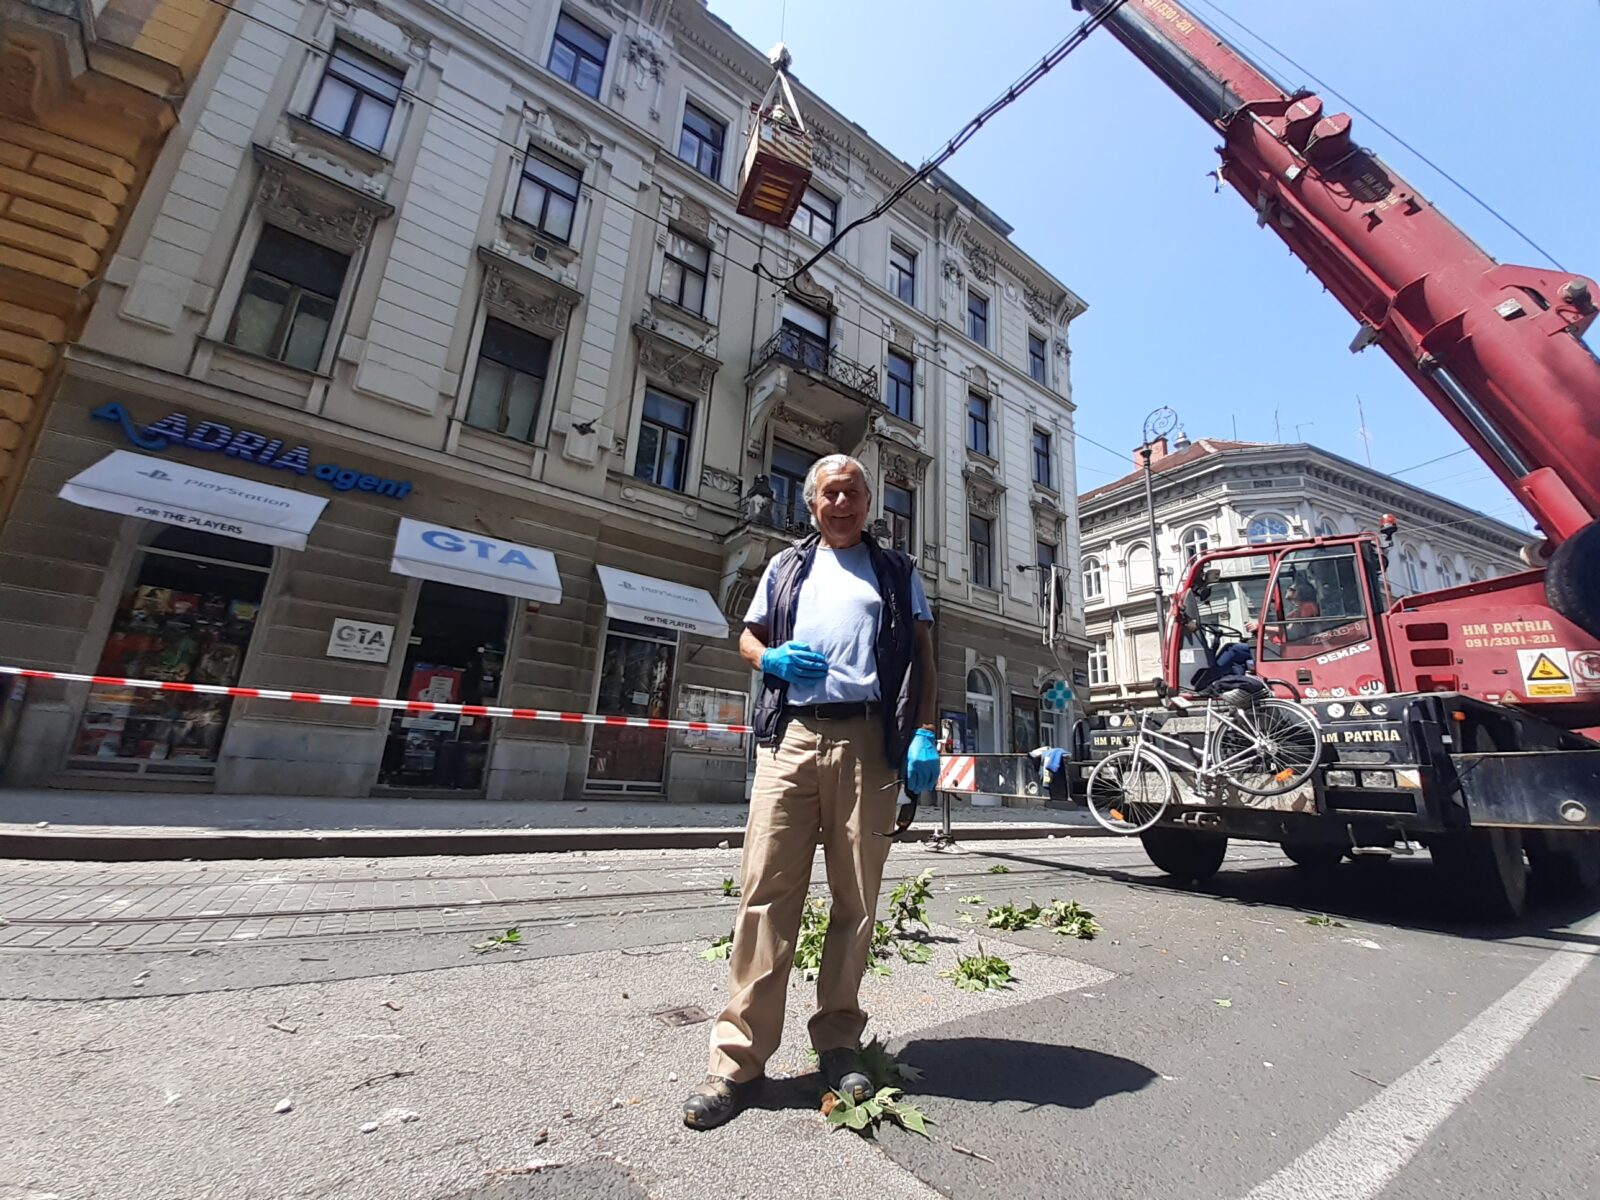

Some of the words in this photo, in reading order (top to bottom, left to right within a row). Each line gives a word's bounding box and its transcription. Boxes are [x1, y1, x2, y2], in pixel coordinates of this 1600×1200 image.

[143, 412, 311, 475] ADRIA
[313, 463, 413, 501] agent
[184, 479, 290, 508] PlayStation
[136, 506, 160, 517] FOR
[162, 510, 186, 523] THE
[188, 516, 244, 534] PLAYERS
[421, 530, 538, 571] GTA
[656, 617, 668, 625] THE
[669, 620, 697, 631] PLAYERS
[1461, 624, 1488, 636] HM
[1492, 620, 1553, 634] PATRIA
[337, 625, 386, 647] GTA
[1465, 634, 1557, 648] 091/3301-201
[1317, 642, 1371, 665] DEMAG
[1093, 736, 1107, 746] HM
[1344, 729, 1401, 743] PATRIA
